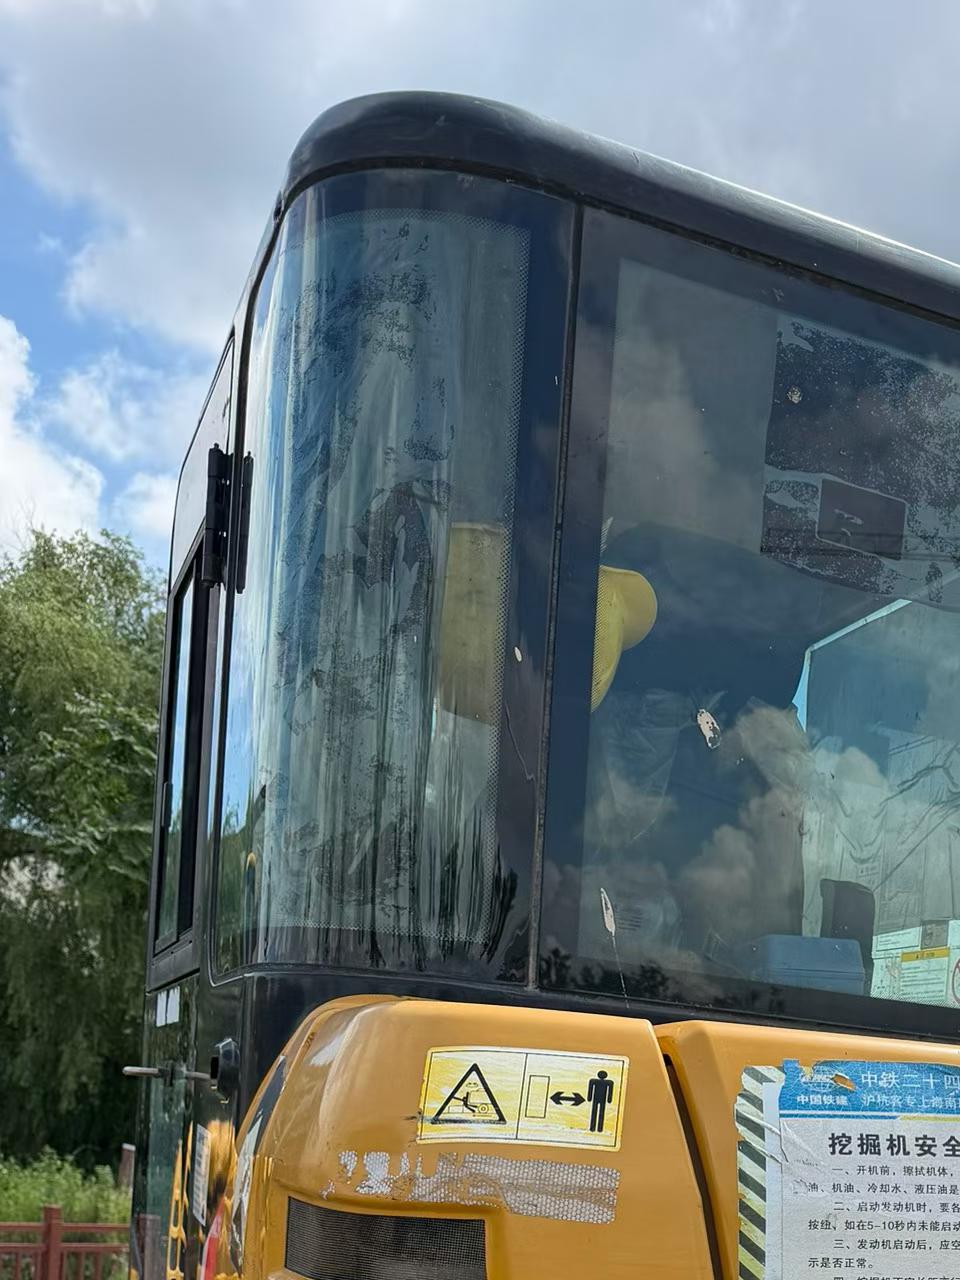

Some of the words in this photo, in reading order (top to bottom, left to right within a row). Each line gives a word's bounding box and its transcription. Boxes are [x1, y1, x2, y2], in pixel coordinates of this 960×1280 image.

[808, 1257, 874, 1269] 示是否正常。
